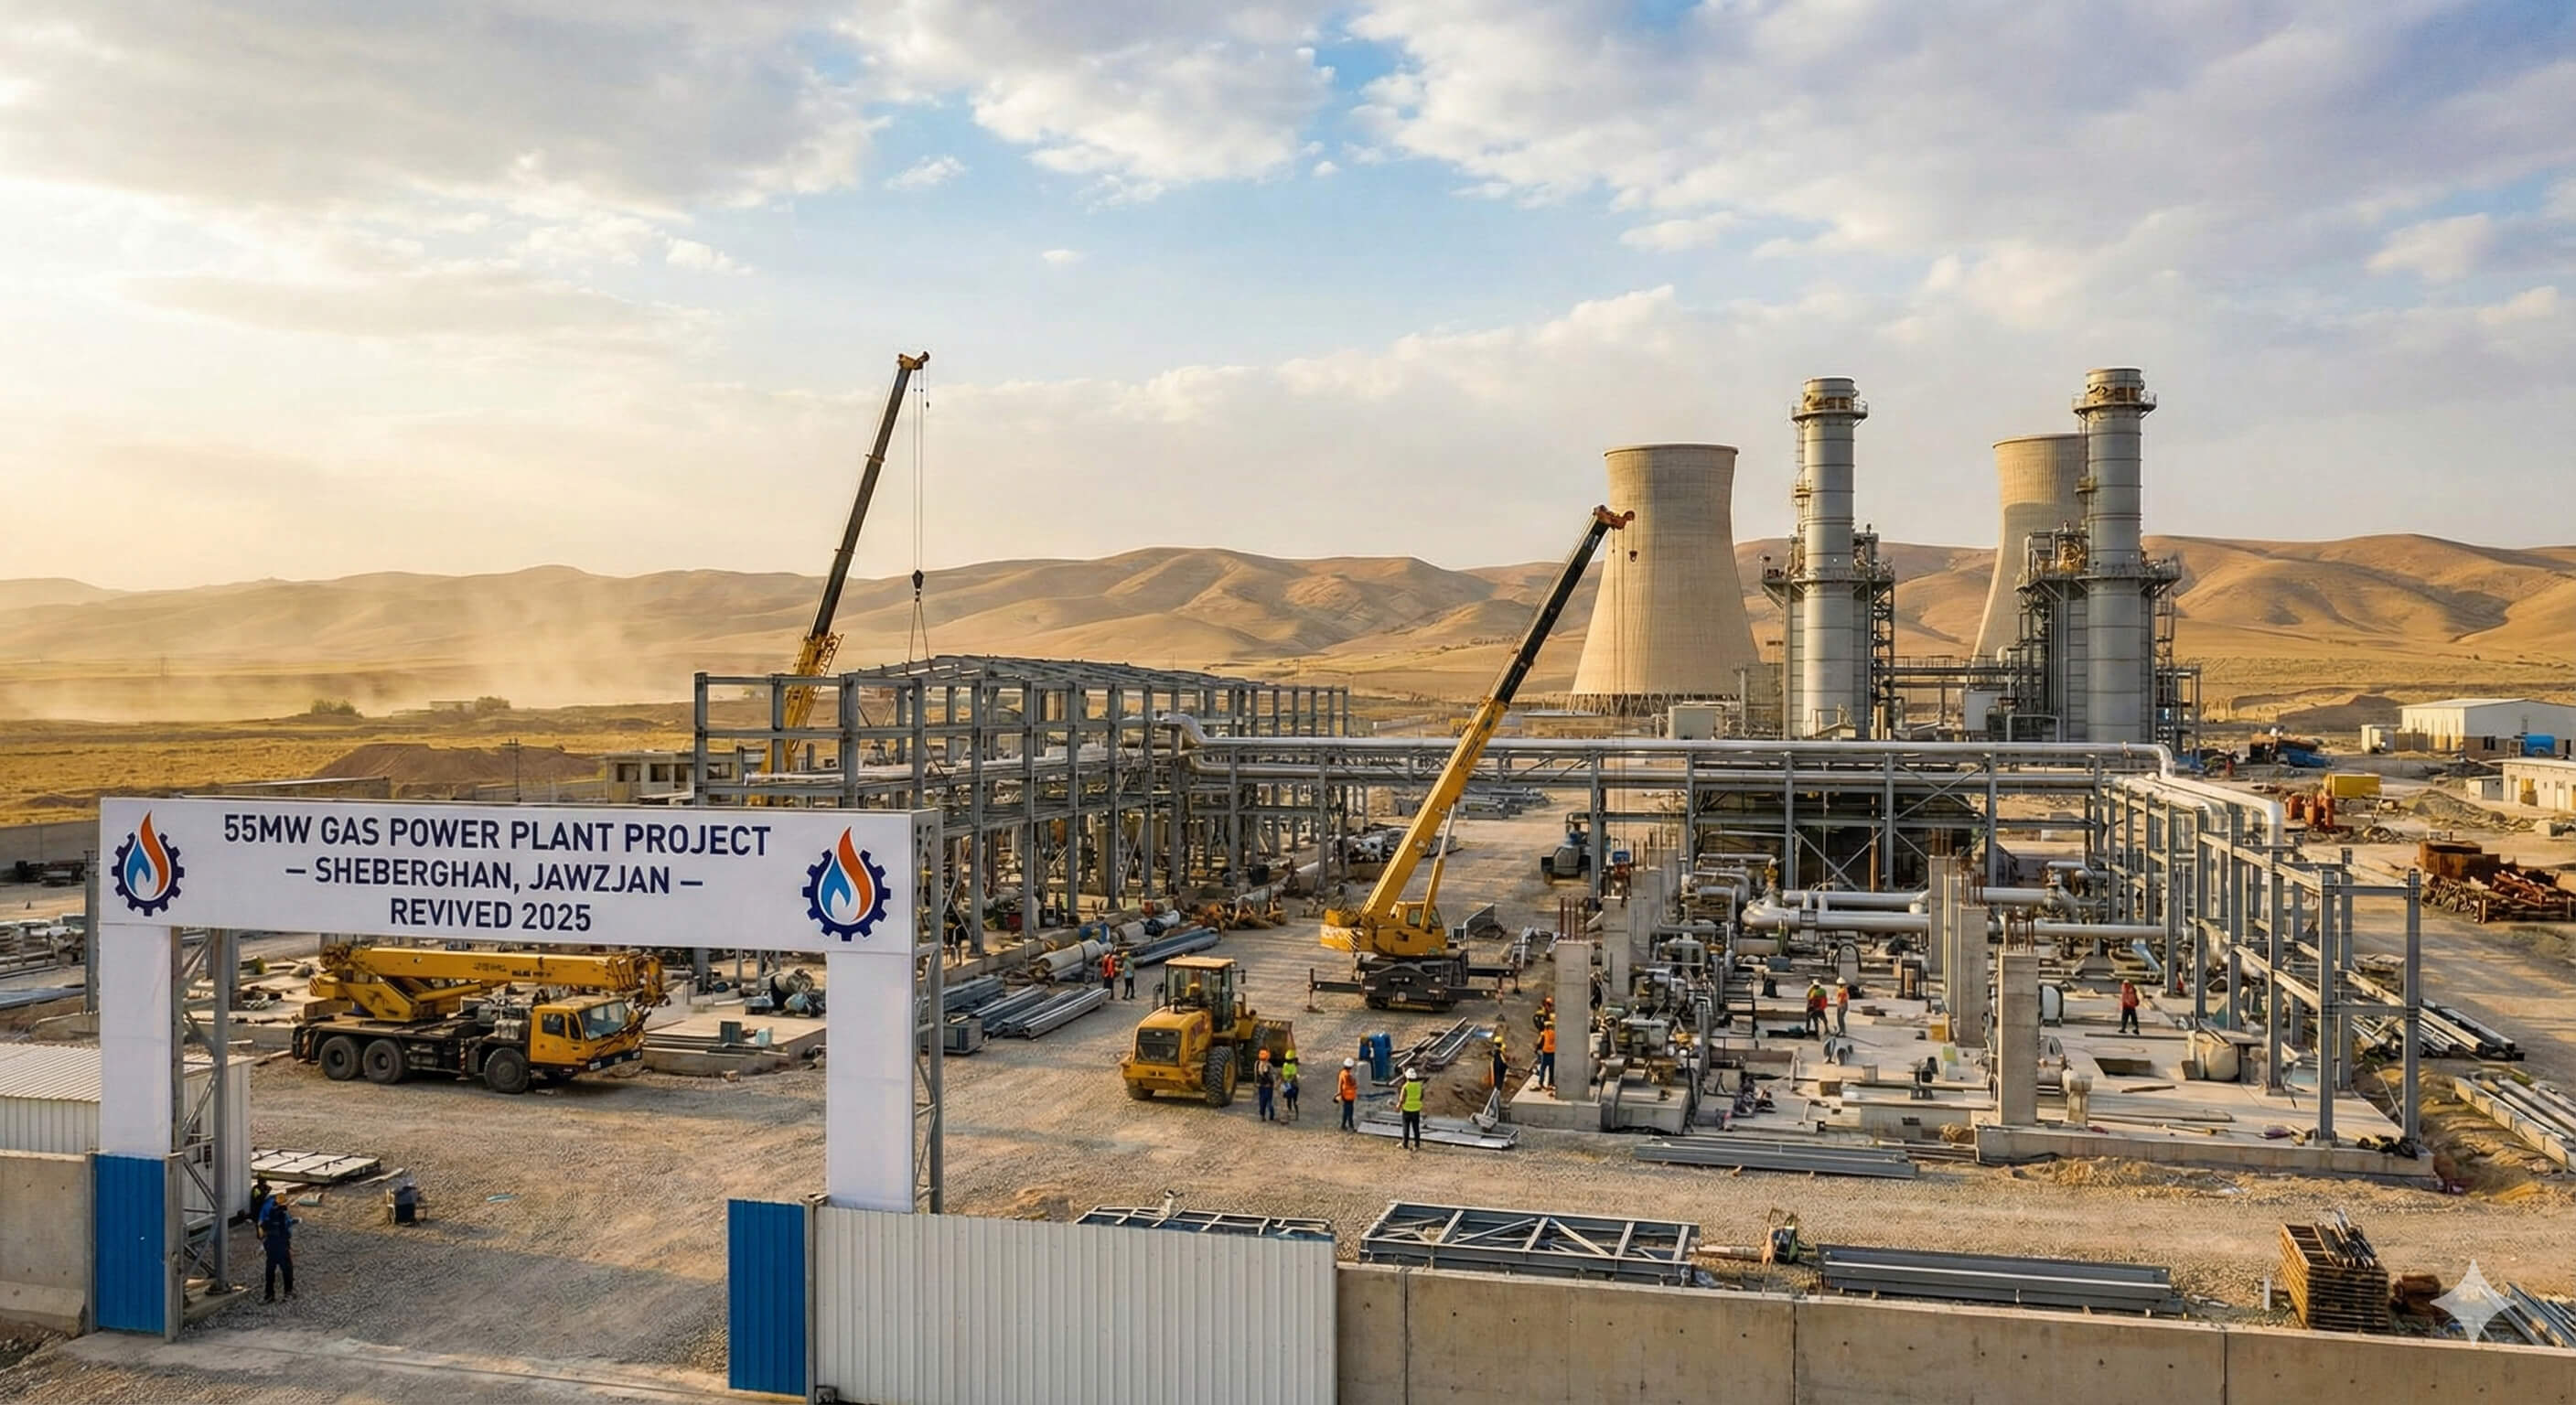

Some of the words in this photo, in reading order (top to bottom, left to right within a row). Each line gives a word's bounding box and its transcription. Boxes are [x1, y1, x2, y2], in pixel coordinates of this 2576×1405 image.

[224, 813, 313, 844] 55MW
[320, 815, 380, 846] GAS
[390, 817, 500, 850] POWER
[510, 820, 615, 853] PLANT
[624, 823, 772, 856] PROJECT
[315, 856, 521, 896] SHEBERGHAN,
[528, 863, 670, 895] JAWZJAN
[390, 897, 512, 929] REVIVED
[521, 902, 592, 932] 2025
